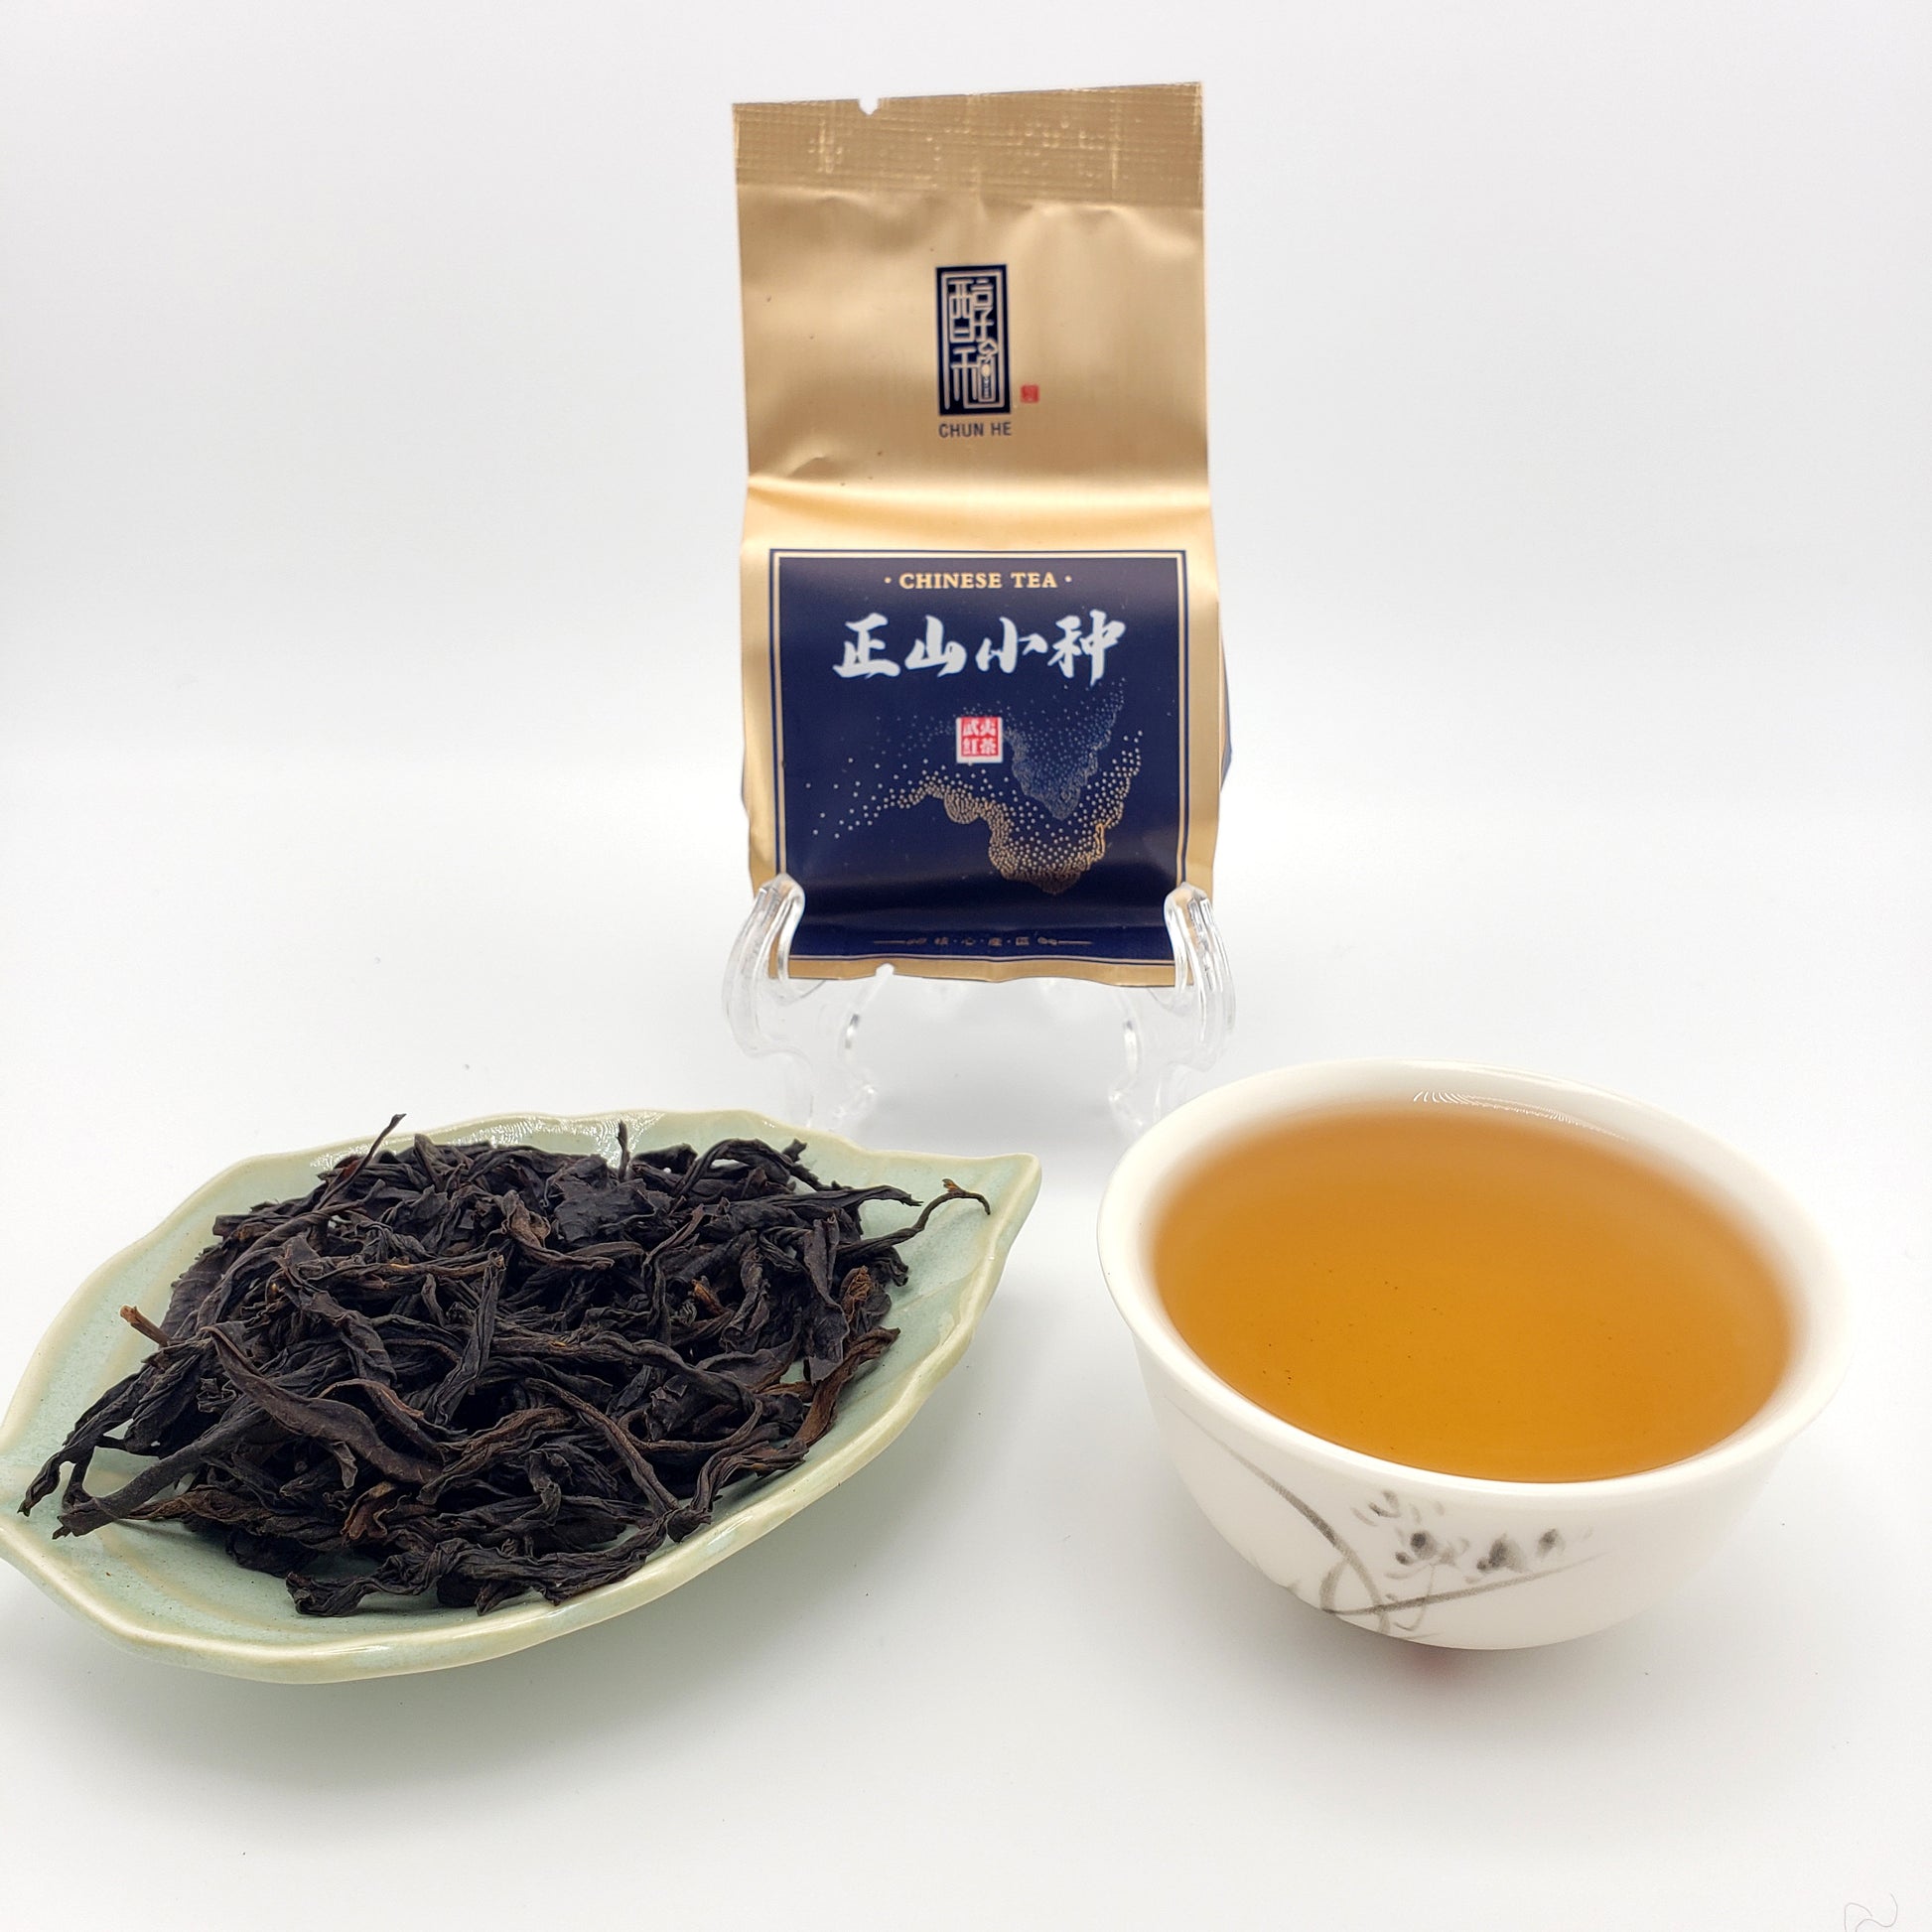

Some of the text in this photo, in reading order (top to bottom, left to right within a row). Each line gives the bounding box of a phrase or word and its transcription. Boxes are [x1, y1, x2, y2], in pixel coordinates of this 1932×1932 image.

[938, 422, 1012, 438] CHUN HE
[898, 571, 1058, 590] CHINESE TEA
[832, 609, 1126, 686] 正山小种
